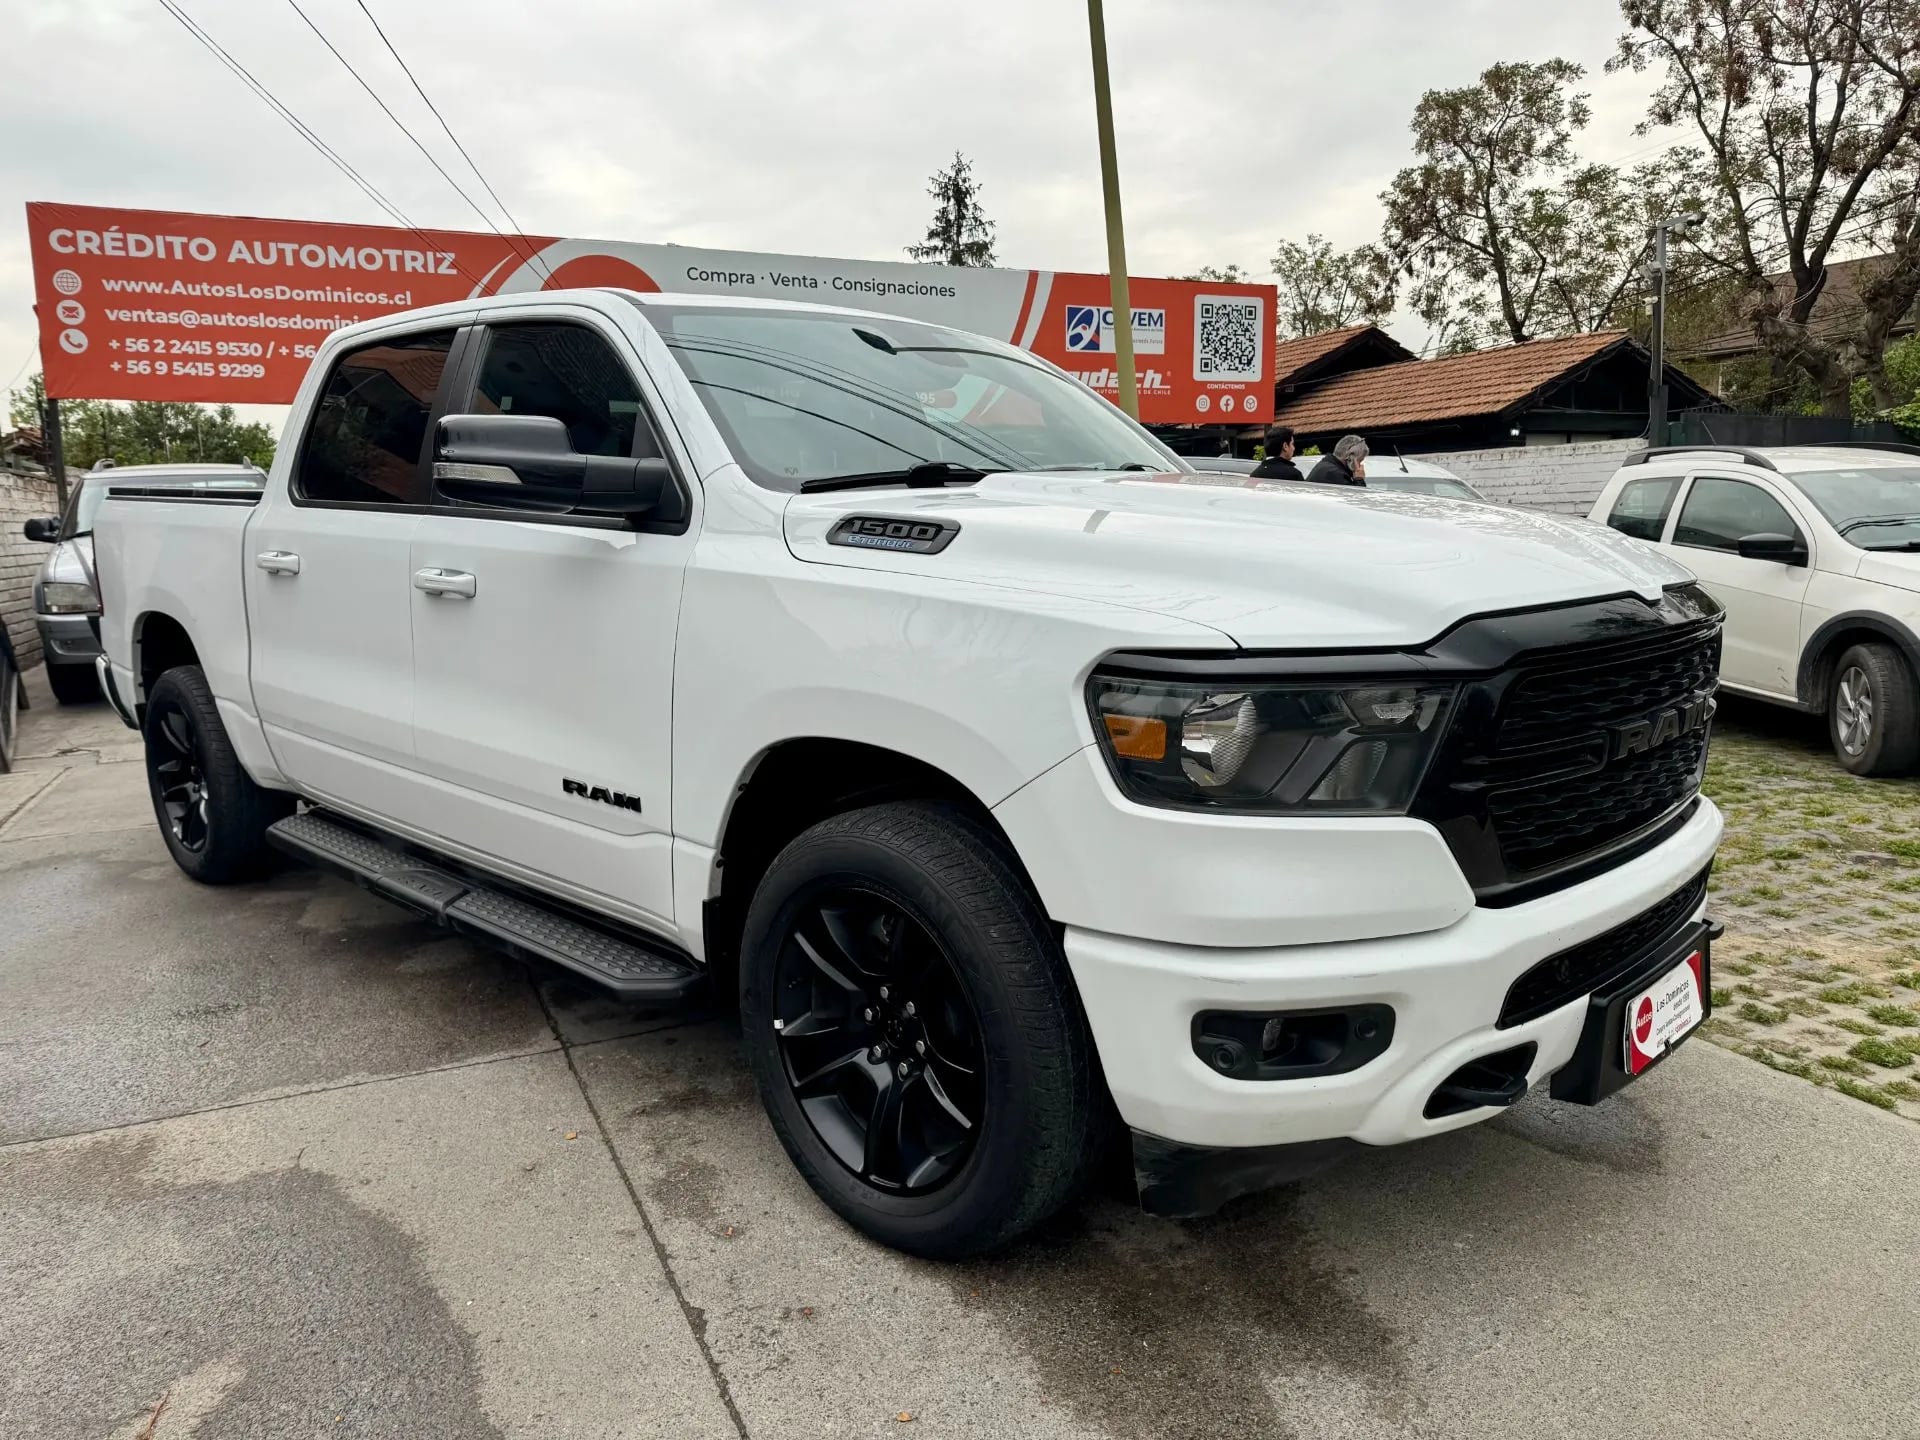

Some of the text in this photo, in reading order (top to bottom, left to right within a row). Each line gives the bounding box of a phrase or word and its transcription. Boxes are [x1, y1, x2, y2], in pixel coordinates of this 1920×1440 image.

[48, 225, 458, 275] CRÉDITO AUTOMOTRIZ
[101, 279, 412, 306] www.AutosLosDominicos.cl
[686, 266, 956, 297] Compra Venta Consignaciones
[1102, 310, 1163, 328] CVEM
[125, 337, 150, 353] 56
[153, 339, 167, 354] 2
[169, 340, 213, 356] 2415
[215, 341, 263, 357] 9530
[293, 344, 317, 359] 56
[126, 359, 151, 375] 56
[154, 361, 168, 376] 9
[172, 361, 215, 377] 5415
[218, 363, 266, 378] 9299
[848, 519, 937, 540] 1500
[1617, 698, 1705, 760] RAM
[562, 777, 642, 814] RAM
